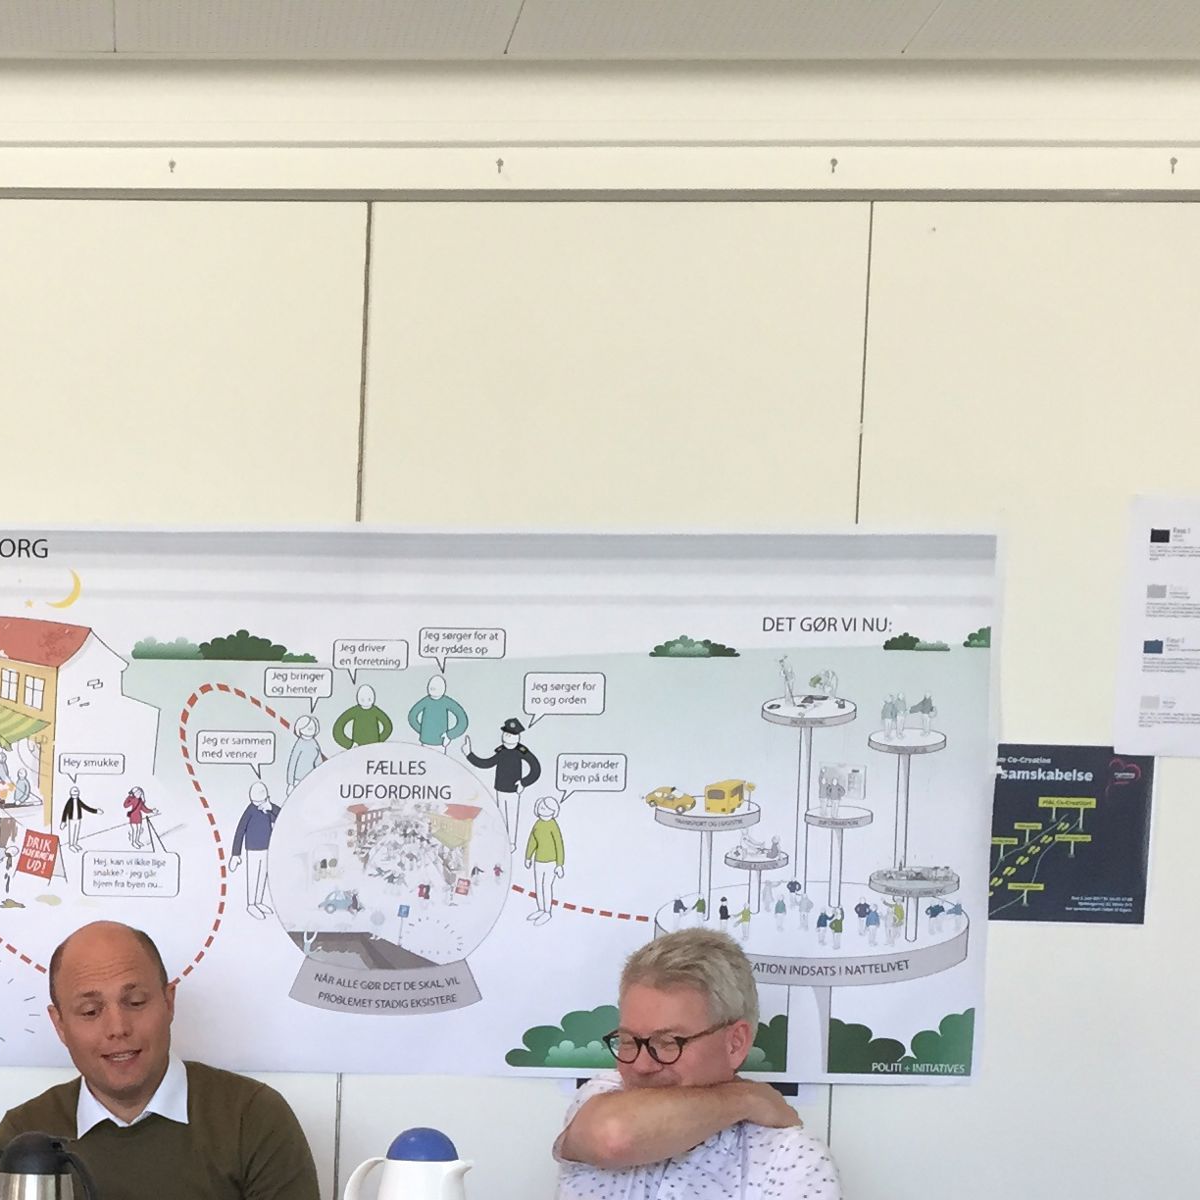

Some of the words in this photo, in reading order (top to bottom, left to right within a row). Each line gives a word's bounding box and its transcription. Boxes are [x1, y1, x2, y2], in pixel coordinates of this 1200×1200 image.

[762, 616, 796, 632] DET
[799, 616, 838, 632] GØR
[841, 616, 857, 632] VI
[862, 617, 893, 633] NU:
[424, 631, 440, 642] Jeg
[442, 632, 472, 643] sørger
[474, 631, 487, 641] for
[489, 632, 499, 641] at
[339, 643, 356, 654] Jeg
[357, 643, 386, 653] driver
[423, 645, 440, 654] der
[441, 645, 473, 657] ryddes
[475, 646, 488, 656] op
[339, 658, 351, 666] en
[353, 657, 400, 668] forretning
[271, 672, 288, 683] Jeg
[290, 672, 325, 683] bringer
[271, 686, 284, 695] og
[286, 685, 318, 694] henter
[531, 682, 548, 693] Jeg
[550, 683, 581, 693] sørger
[582, 682, 596, 691] for
[531, 696, 542, 704] ro
[543, 696, 556, 707] og
[558, 696, 587, 705] orden
[202, 736, 218, 747] Jeg
[220, 737, 229, 745] er
[231, 737, 272, 746] sammen
[202, 749, 223, 759] med
[225, 751, 258, 759] venner
[63, 758, 80, 769] Hey
[83, 758, 119, 767] smukke
[366, 760, 427, 776] FÆLLES
[562, 761, 578, 771] Jeg
[581, 760, 619, 770] brander
[562, 773, 586, 785] byen
[588, 772, 601, 785] på
[602, 773, 618, 783] det
[1000, 768, 1093, 781] samskabelse
[340, 784, 452, 800] UDFORDRING
[26, 835, 52, 852] DRIK
[26, 858, 46, 874] UD!
[789, 965, 836, 976] INDSATS
[845, 959, 910, 975] NATTELIVET
[314, 973, 334, 985] NÅR
[336, 978, 359, 989] ALLE
[360, 980, 381, 990] GØR
[383, 981, 402, 991] DET
[403, 981, 417, 991] DE
[445, 975, 460, 986] VIL
[318, 991, 373, 1008] PROBLEMET
[375, 999, 409, 1009] STADIG
[410, 993, 457, 1008] EKSISTERE
[871, 1062, 902, 1072] POLITI
[912, 1063, 965, 1073] INITIATIVES
